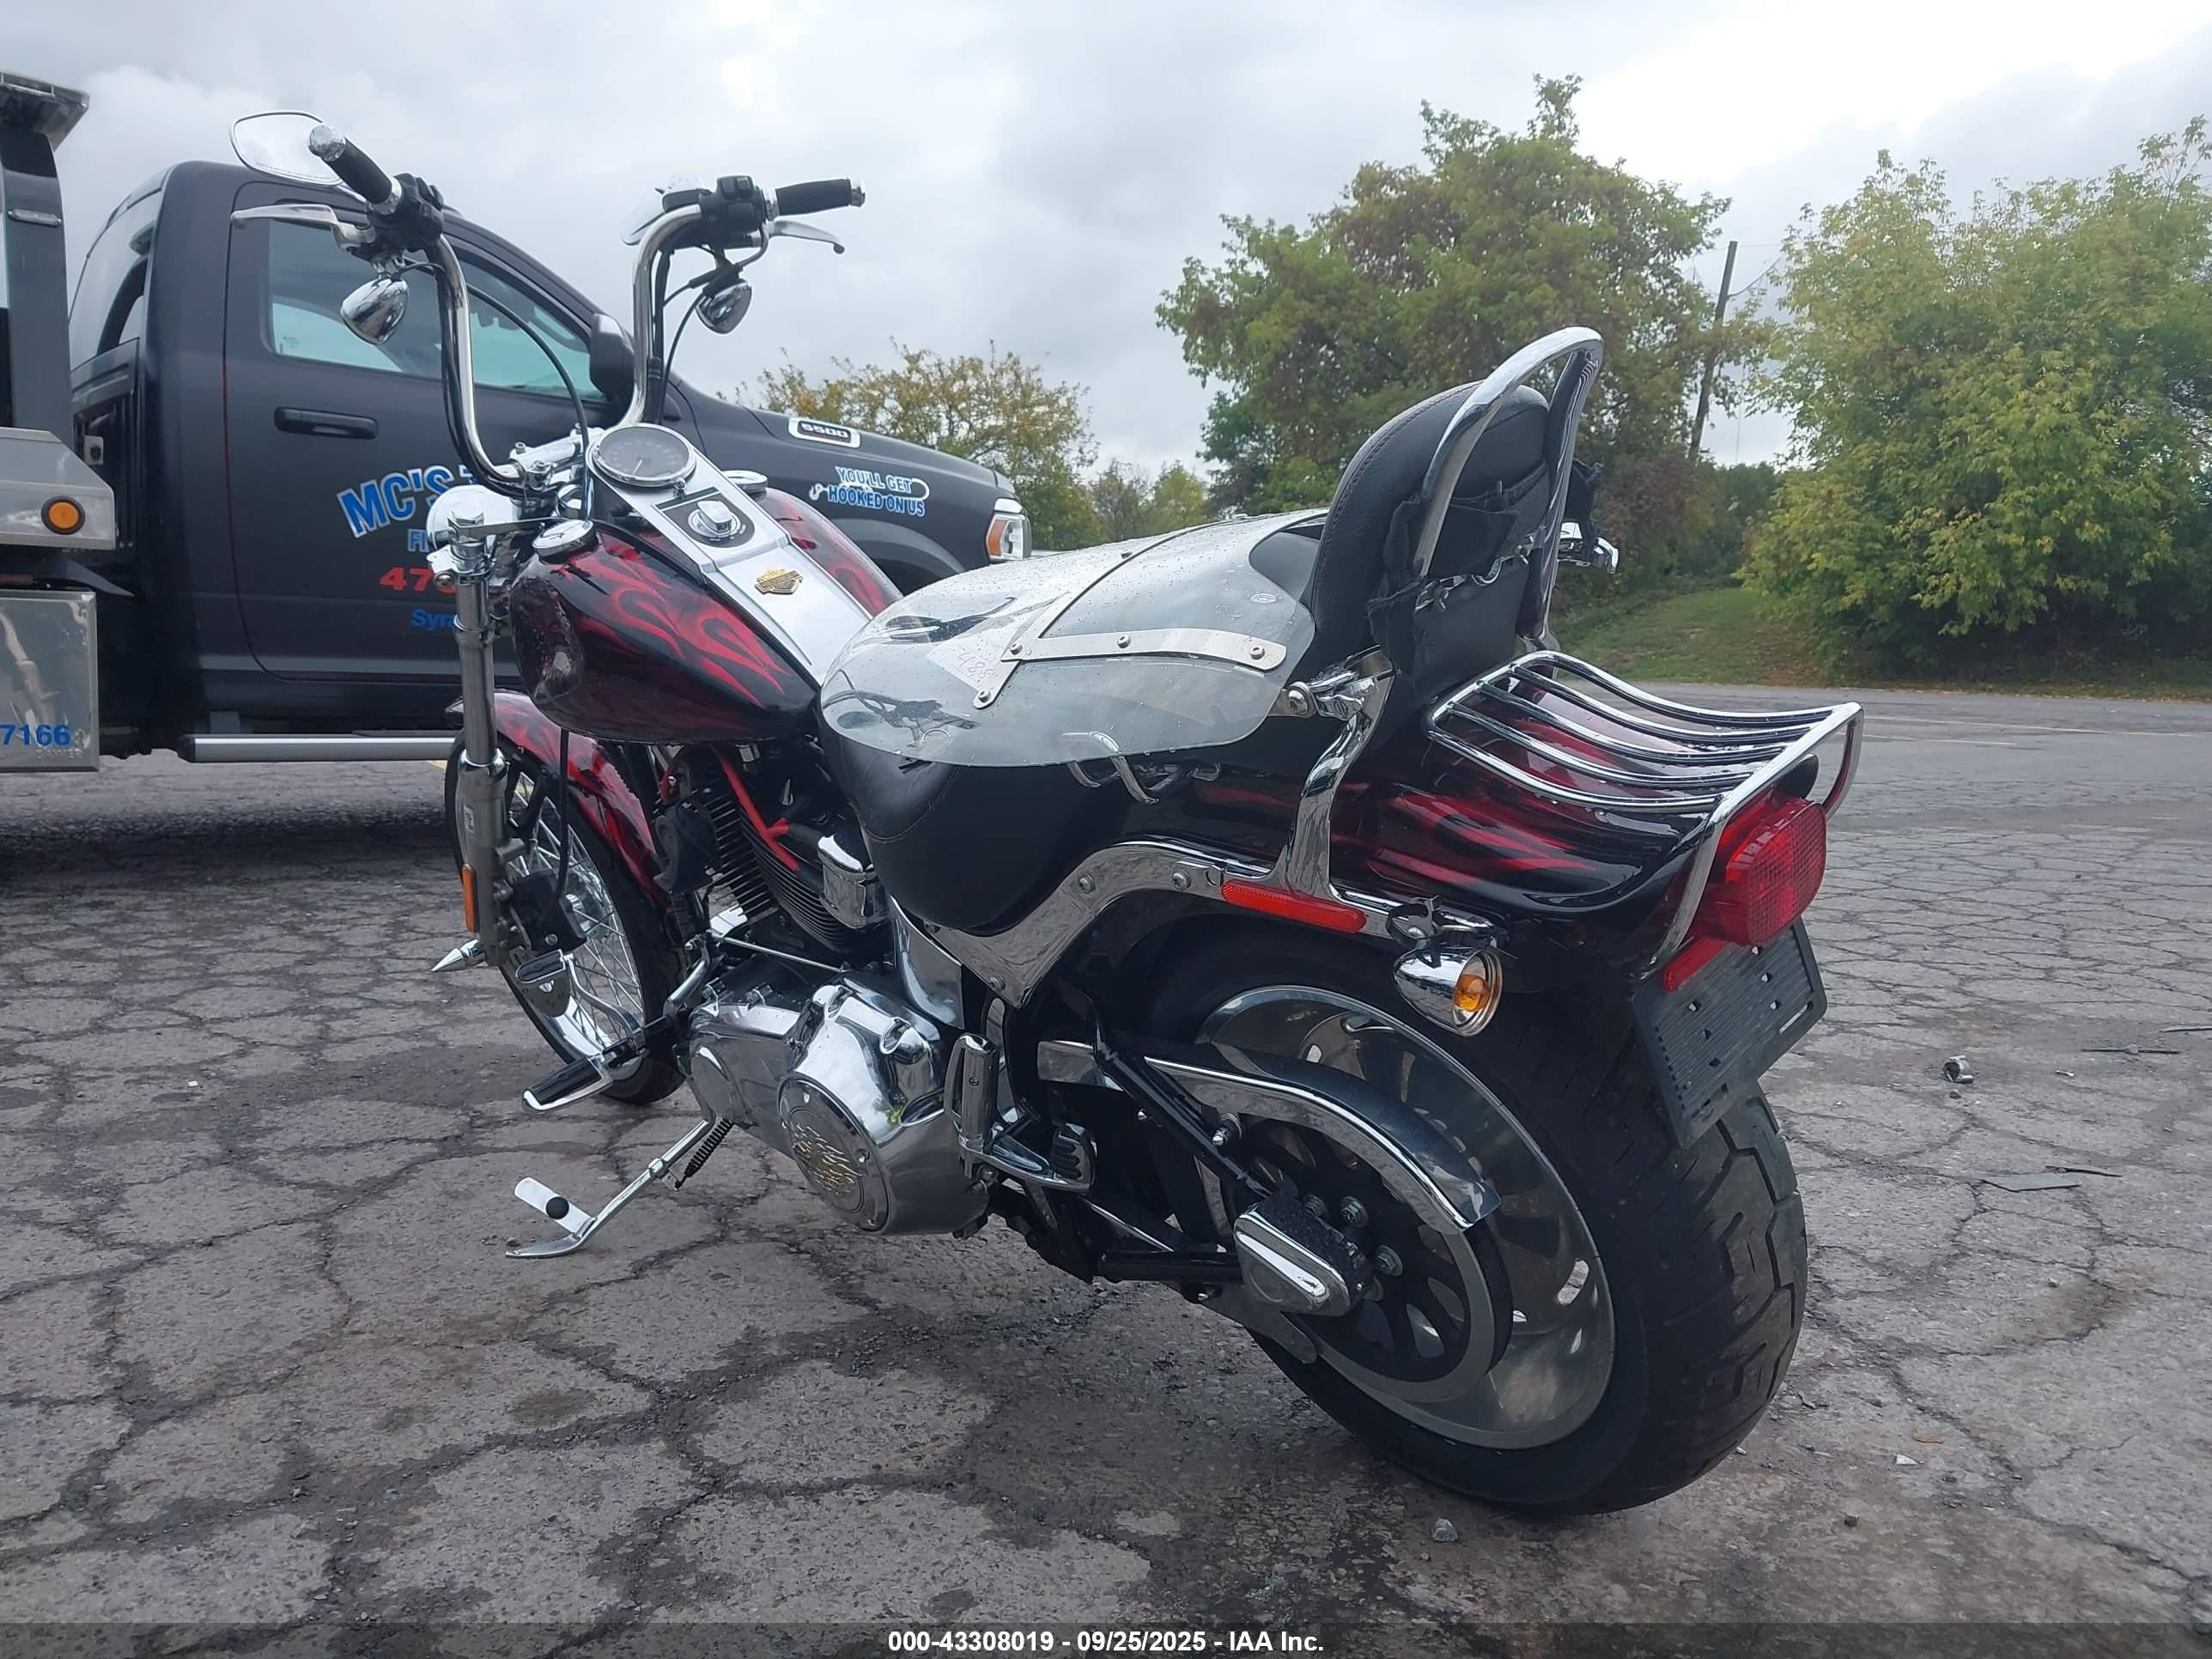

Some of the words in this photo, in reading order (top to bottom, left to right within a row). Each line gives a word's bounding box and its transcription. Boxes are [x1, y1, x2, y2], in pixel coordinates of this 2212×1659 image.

[800, 422, 850, 439] 5500
[835, 465, 885, 489] YOU'LL
[885, 474, 912, 495] GET
[337, 465, 454, 538] MC'S
[828, 484, 884, 510] HOOKED
[884, 494, 906, 514] ON
[906, 497, 927, 517] US
[380, 567, 456, 594] 47
